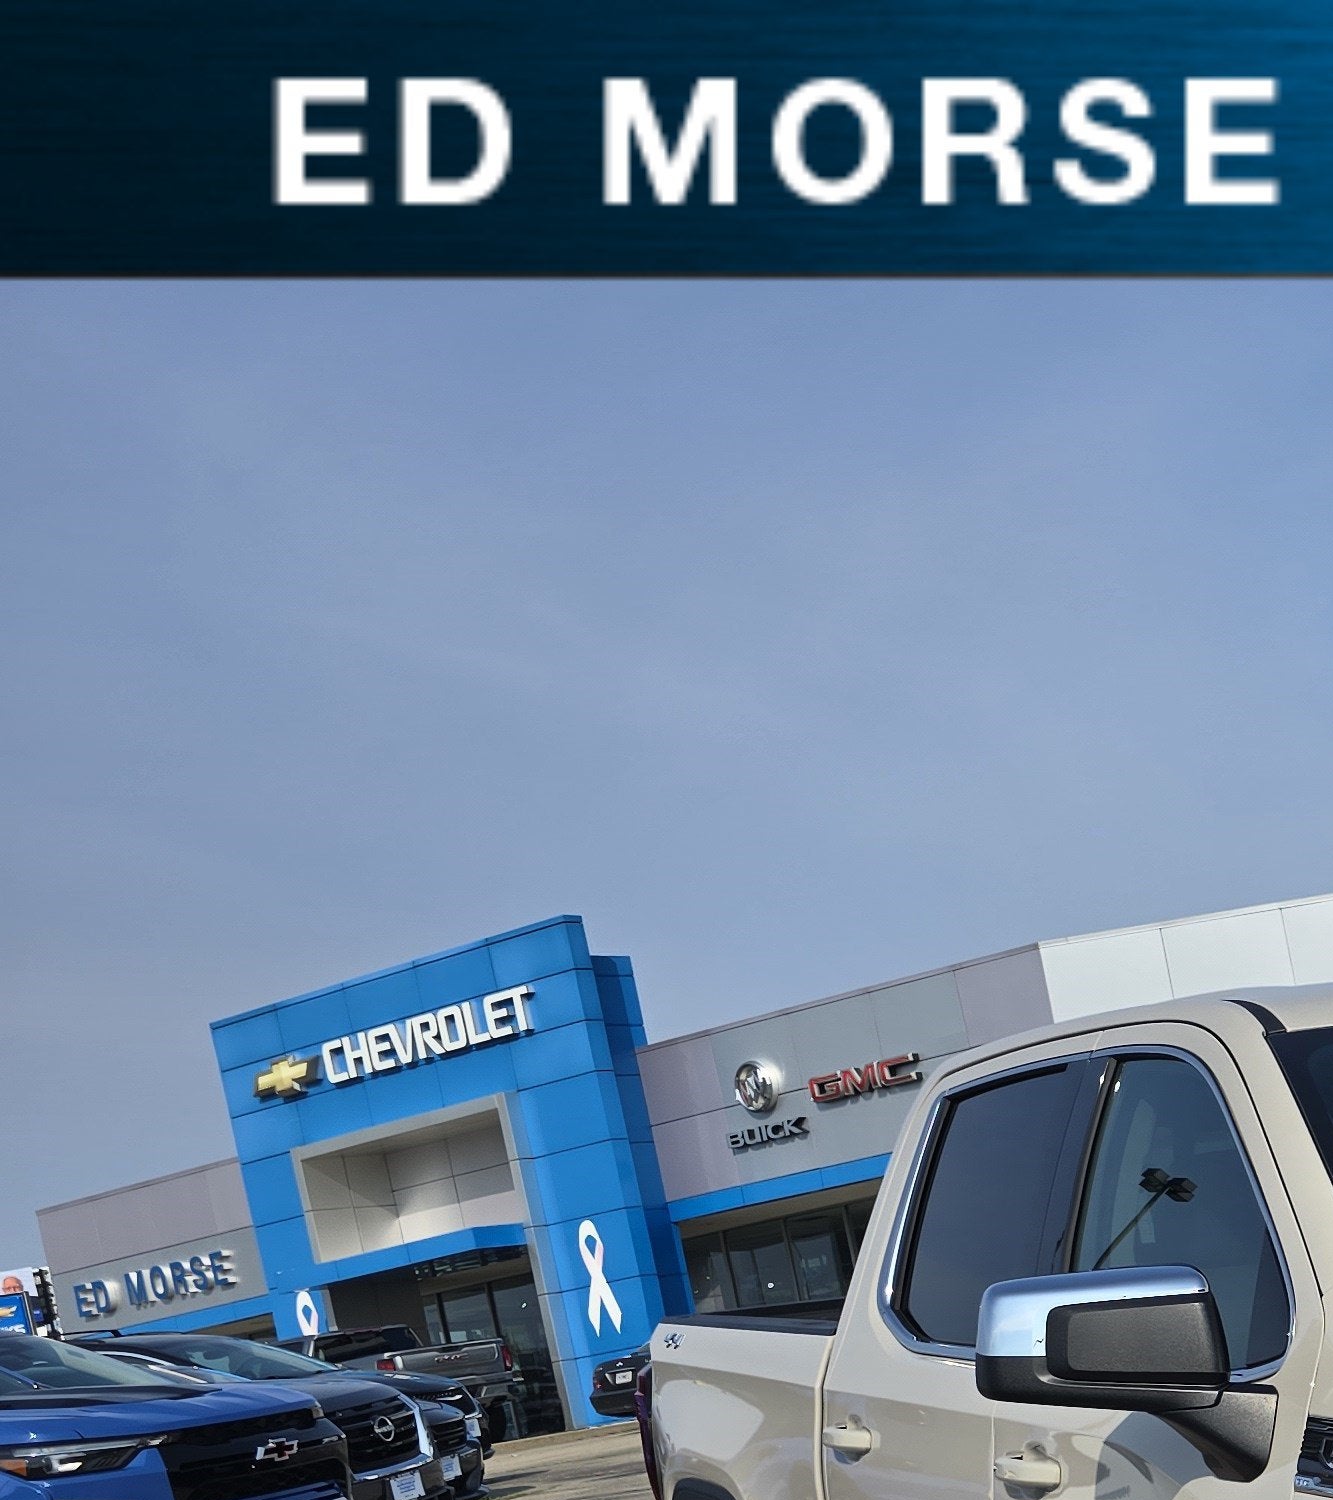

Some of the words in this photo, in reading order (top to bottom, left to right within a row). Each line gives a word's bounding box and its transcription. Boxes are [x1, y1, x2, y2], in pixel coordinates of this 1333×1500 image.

[321, 984, 532, 1084] CHEVROLET
[808, 1052, 924, 1103] GMC
[727, 1116, 811, 1150] BUICK
[73, 1278, 116, 1318] ED
[124, 1249, 238, 1306] MORSE
